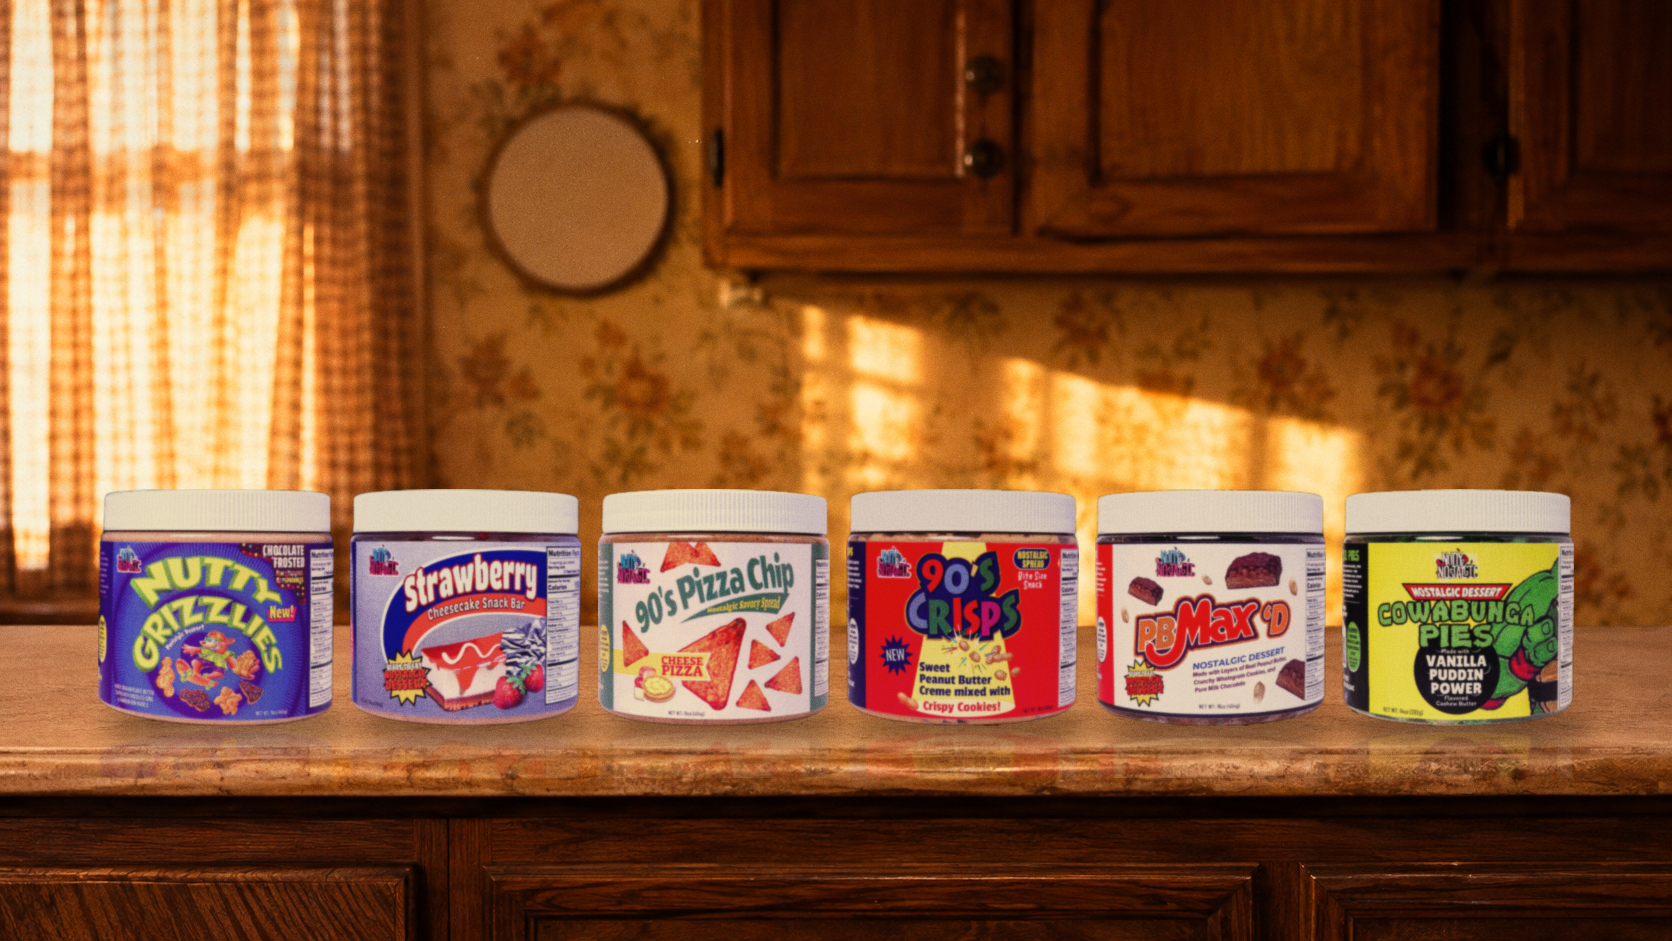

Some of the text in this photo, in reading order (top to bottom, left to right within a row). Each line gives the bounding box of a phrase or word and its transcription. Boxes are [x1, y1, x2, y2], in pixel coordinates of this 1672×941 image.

[262, 544, 305, 556] CHOCOLATE
[1017, 550, 1049, 560] NOSTALGIC
[273, 557, 305, 568] FROSTED
[1022, 559, 1045, 568] SPREAD
[920, 554, 997, 594] 90'S
[1018, 571, 1033, 581] Bite
[1437, 564, 1479, 579] NOSTALGIC
[130, 556, 283, 610] NUTTY
[403, 553, 538, 613] Strawberry
[1023, 580, 1042, 590] Snack
[635, 552, 795, 633] 90's Pizza Chip
[1410, 587, 1504, 598] NOSTALGIC DESSERT
[427, 596, 526, 621] Cheesecake Snack Bar
[707, 596, 781, 613] Nostalgic Savory Spread
[269, 605, 294, 619] New!
[908, 592, 1019, 637] CRISPS
[1377, 599, 1535, 627] COWABUNGA
[132, 595, 283, 674] GRIZZLIES
[1138, 616, 1176, 652] PB
[1145, 599, 1258, 667] Max
[1418, 623, 1494, 648] PIES
[661, 656, 704, 666] CHEESE
[885, 648, 905, 662] NEW
[1192, 646, 1285, 670] NOSTALGIC DESSERT
[1425, 654, 1487, 667] VANILLA
[661, 665, 704, 677] PIZZA
[919, 661, 951, 673] Sweet
[1221, 667, 1238, 675] Layers
[384, 668, 427, 681] NOSTALGIC
[919, 673, 992, 685] Peanut Butter
[1125, 675, 1163, 685] NOSTALGIC
[1216, 673, 1246, 682] Wholegrain
[1429, 668, 1484, 681] PUDDIN
[385, 678, 428, 691] DESSERT
[919, 685, 1011, 697] Creme mixed with
[1127, 684, 1164, 696] DESSERT
[1220, 681, 1246, 689] Chocolate
[1430, 682, 1483, 695] POWER
[923, 701, 1001, 714] Crispy Cookies!
